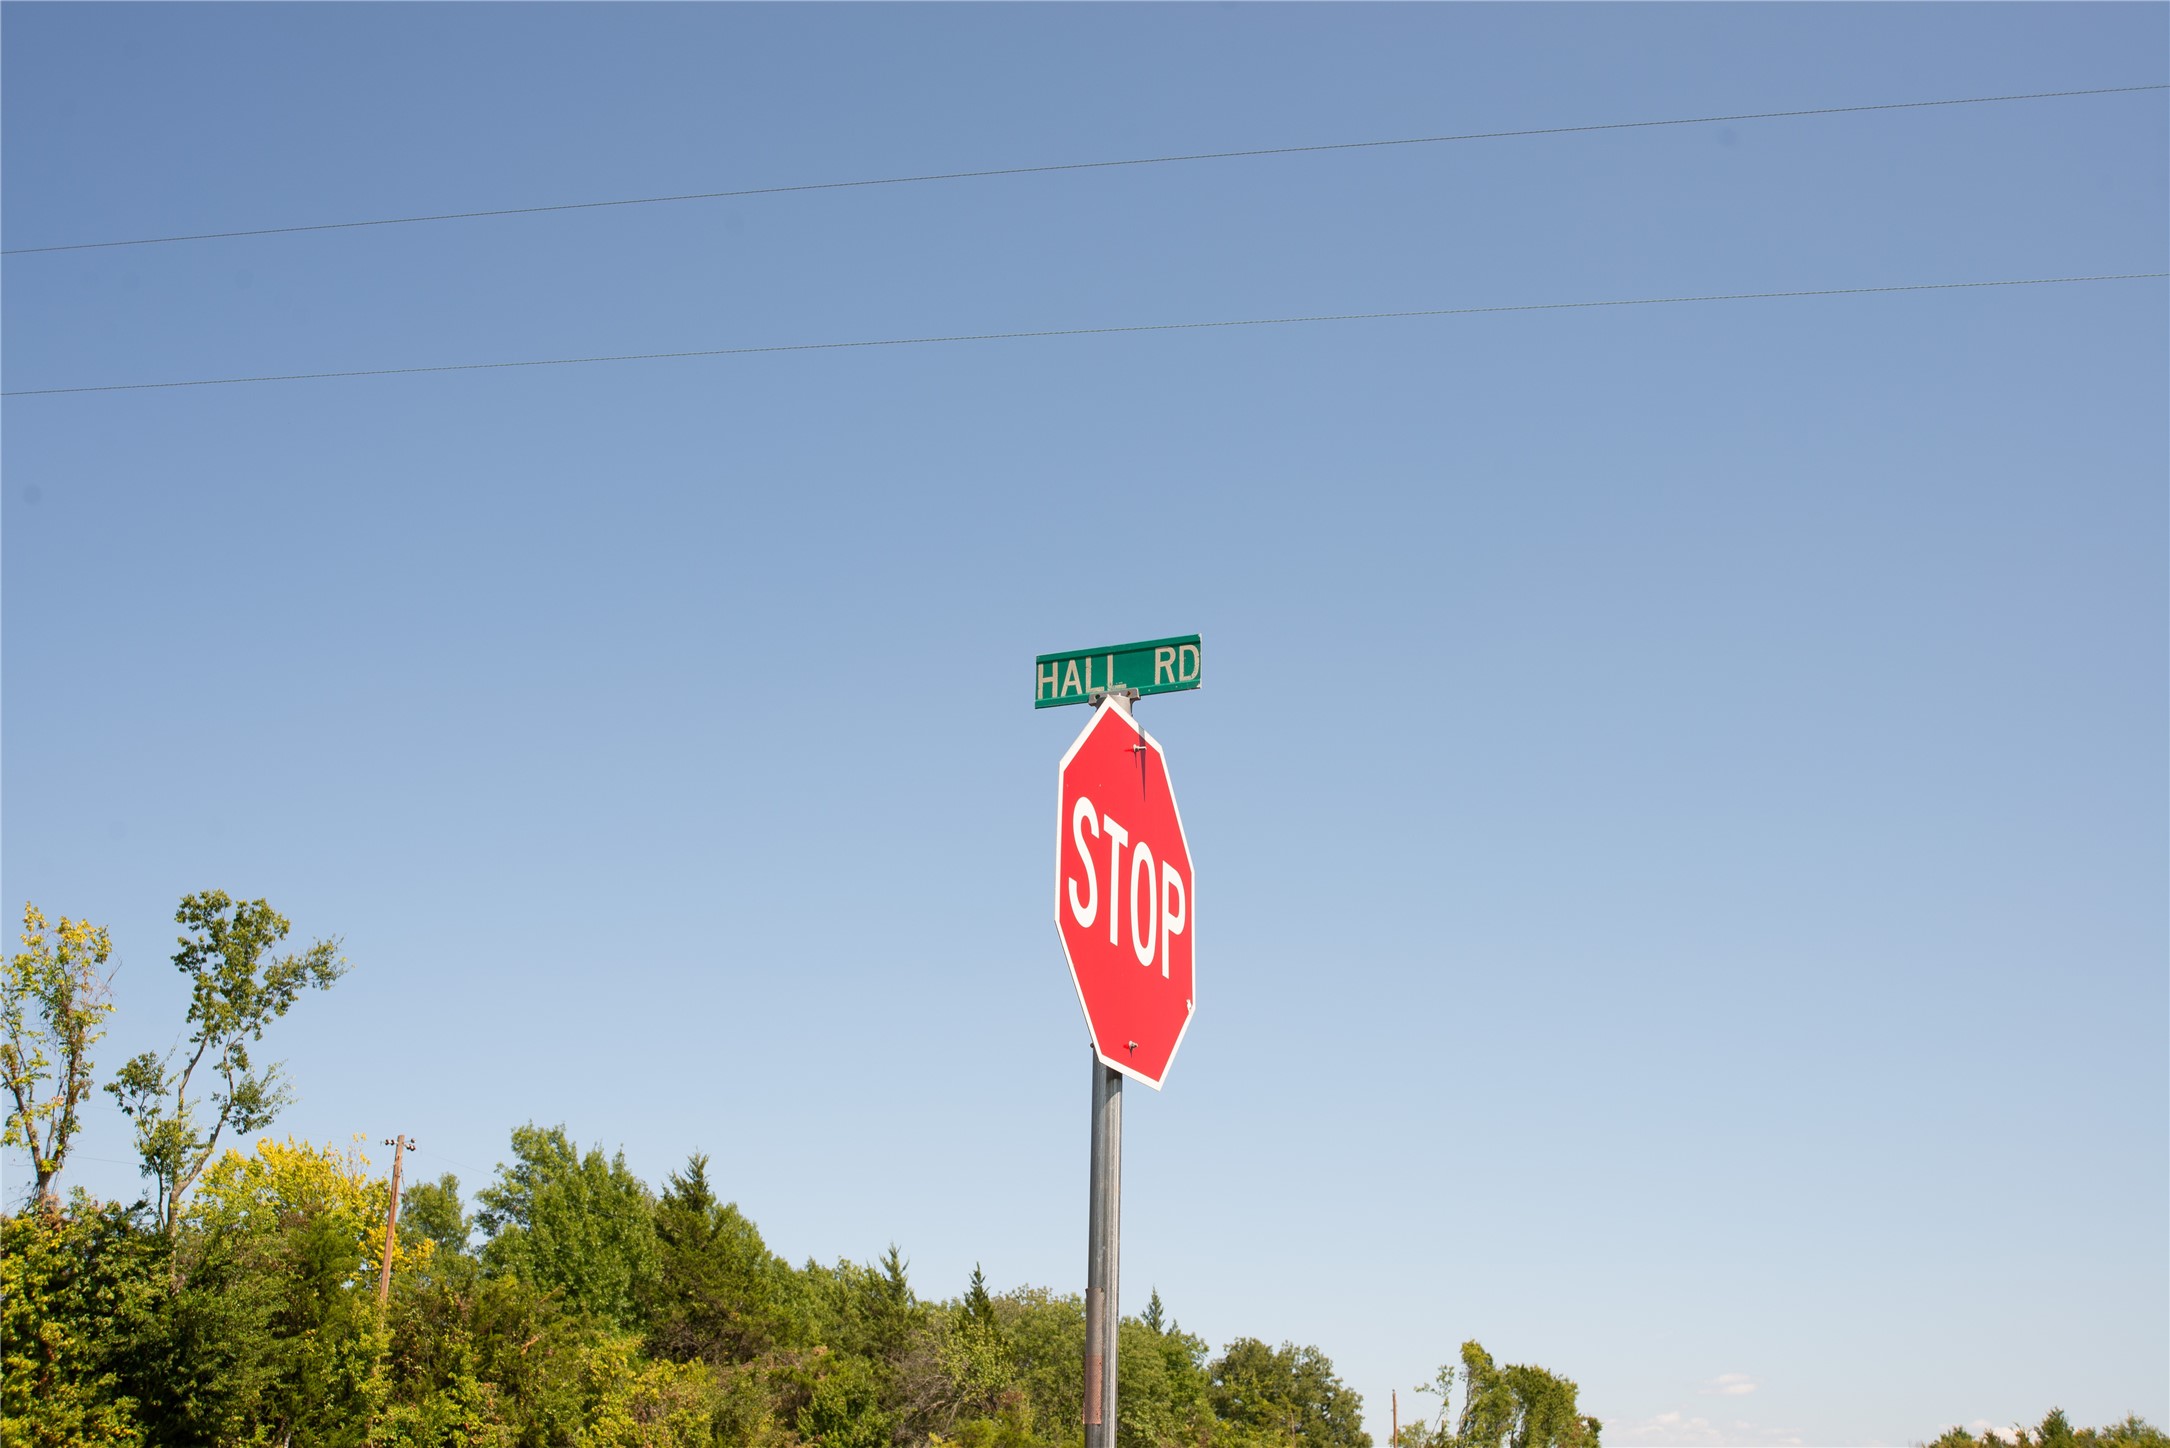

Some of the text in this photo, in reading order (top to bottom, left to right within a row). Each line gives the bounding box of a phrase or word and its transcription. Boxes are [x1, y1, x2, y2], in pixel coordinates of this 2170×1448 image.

[1037, 644, 1200, 699] HALL RD
[1068, 796, 1186, 979] STOP
